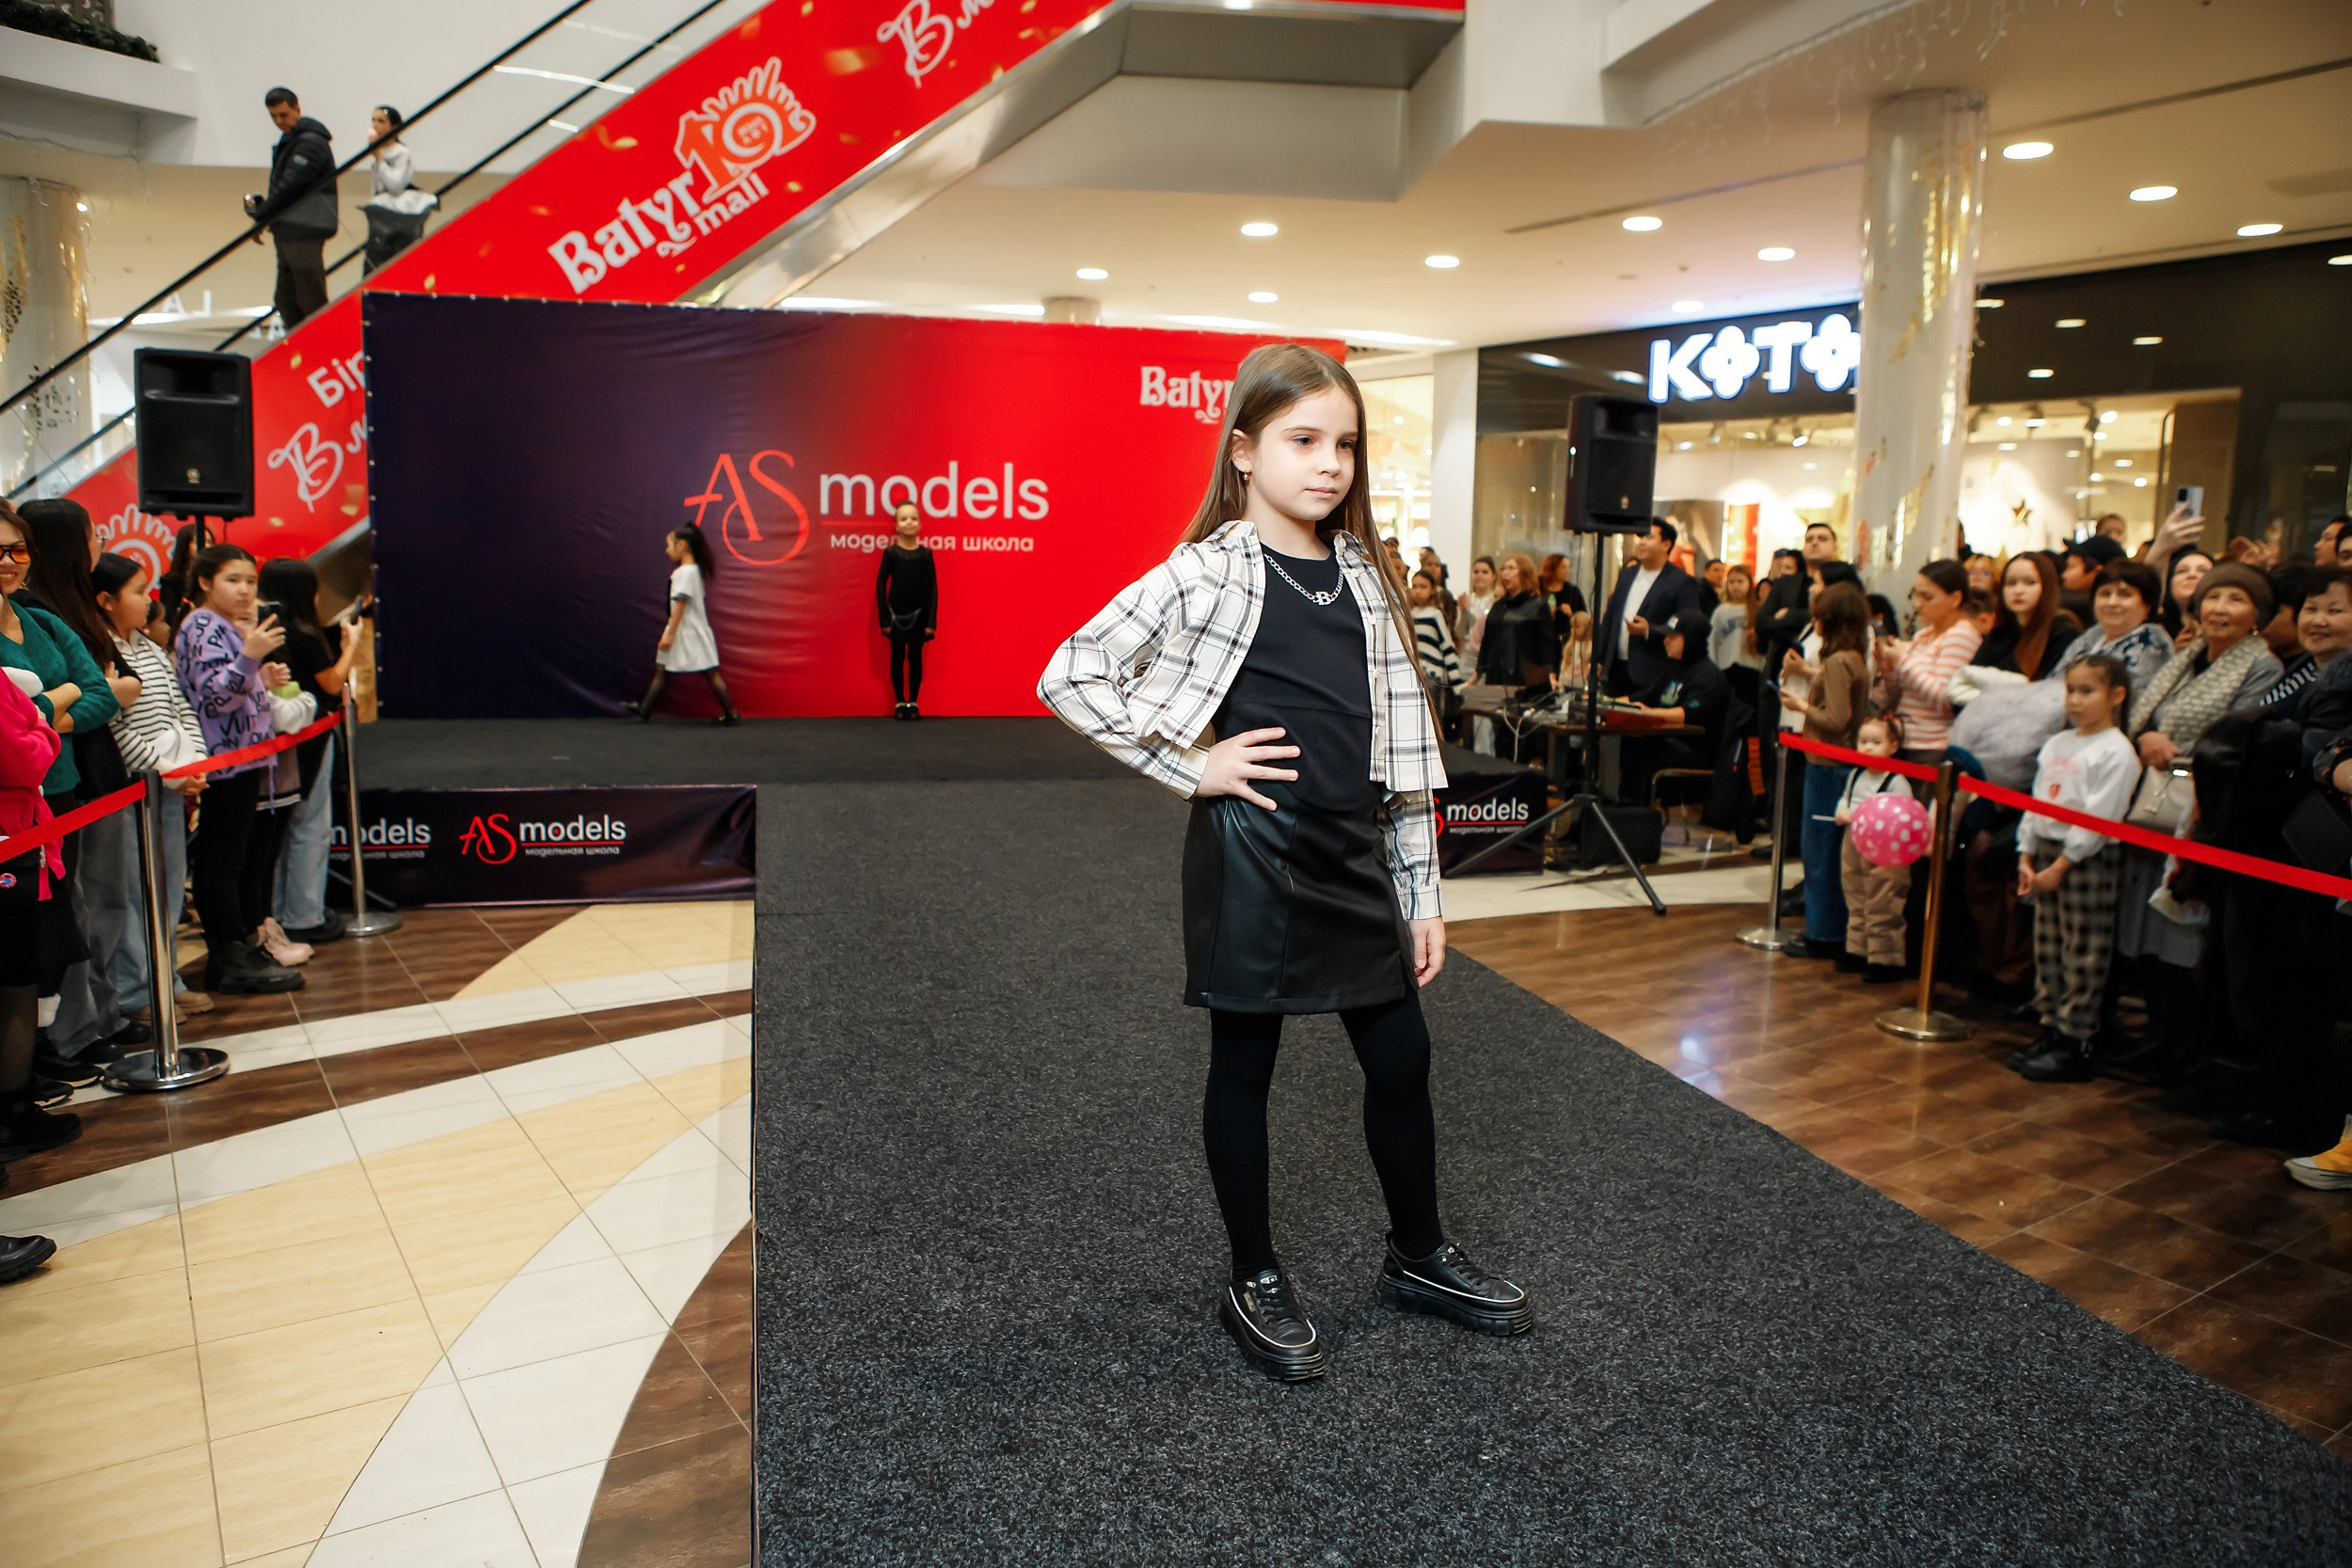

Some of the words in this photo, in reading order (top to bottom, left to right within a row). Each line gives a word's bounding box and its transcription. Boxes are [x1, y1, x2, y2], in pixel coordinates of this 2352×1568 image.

[547, 170, 702, 294] Batyr
[692, 172, 771, 236] mall
[684, 450, 810, 566] AS
[819, 461, 1050, 520] models
[831, 533, 956, 553] моделная
[962, 536, 1034, 552] школа
[1446, 797, 1529, 821] models
[459, 814, 516, 864] AS
[519, 815, 628, 842] models
